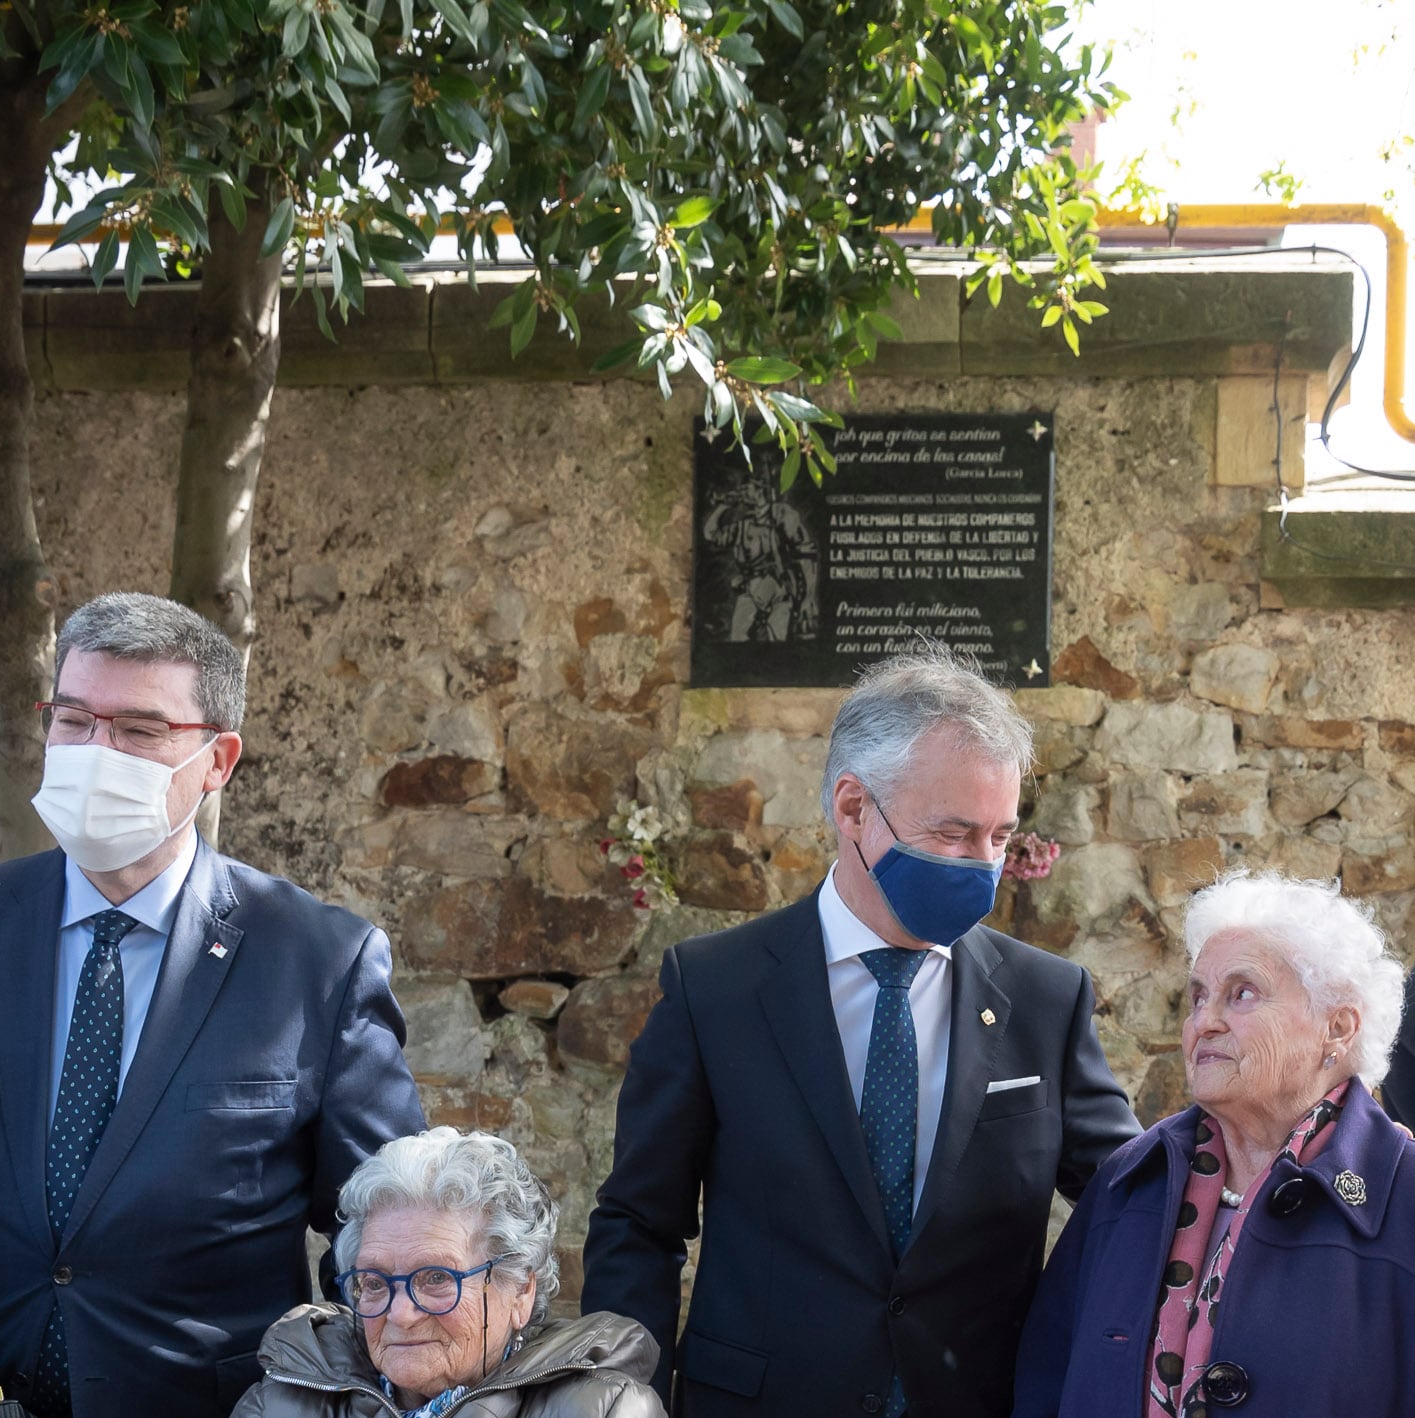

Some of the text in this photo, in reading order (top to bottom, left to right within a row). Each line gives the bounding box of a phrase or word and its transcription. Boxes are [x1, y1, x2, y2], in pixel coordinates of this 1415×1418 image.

[859, 431, 884, 448] que
[913, 446, 931, 463] de
[933, 446, 955, 463] las
[830, 514, 837, 527] A
[839, 514, 853, 527] LA
[854, 513, 901, 527] MEMORIA
[902, 513, 915, 527] DE
[886, 531, 900, 544] EN
[902, 531, 947, 544] DEFENSA
[949, 530, 963, 544] DE
[965, 530, 980, 544] LA
[982, 530, 1029, 544] LIBERTAD
[1032, 530, 1039, 544] Y
[830, 549, 844, 561] LA
[847, 549, 890, 561] JUSTICIA
[892, 548, 912, 561] DEL
[915, 548, 954, 561] PUEBLO
[992, 548, 1013, 561] POR
[1015, 547, 1035, 561] LOS
[829, 566, 880, 579] ENEMIGOS
[882, 566, 896, 579] DE
[898, 566, 913, 579] LA
[914, 566, 933, 579] PAZ
[936, 566, 943, 578] Y
[946, 566, 961, 579] LA
[836, 600, 893, 617] Primero
[836, 624, 855, 636] un
[934, 620, 950, 636] el
[836, 642, 861, 653] con
[863, 642, 882, 653] un
